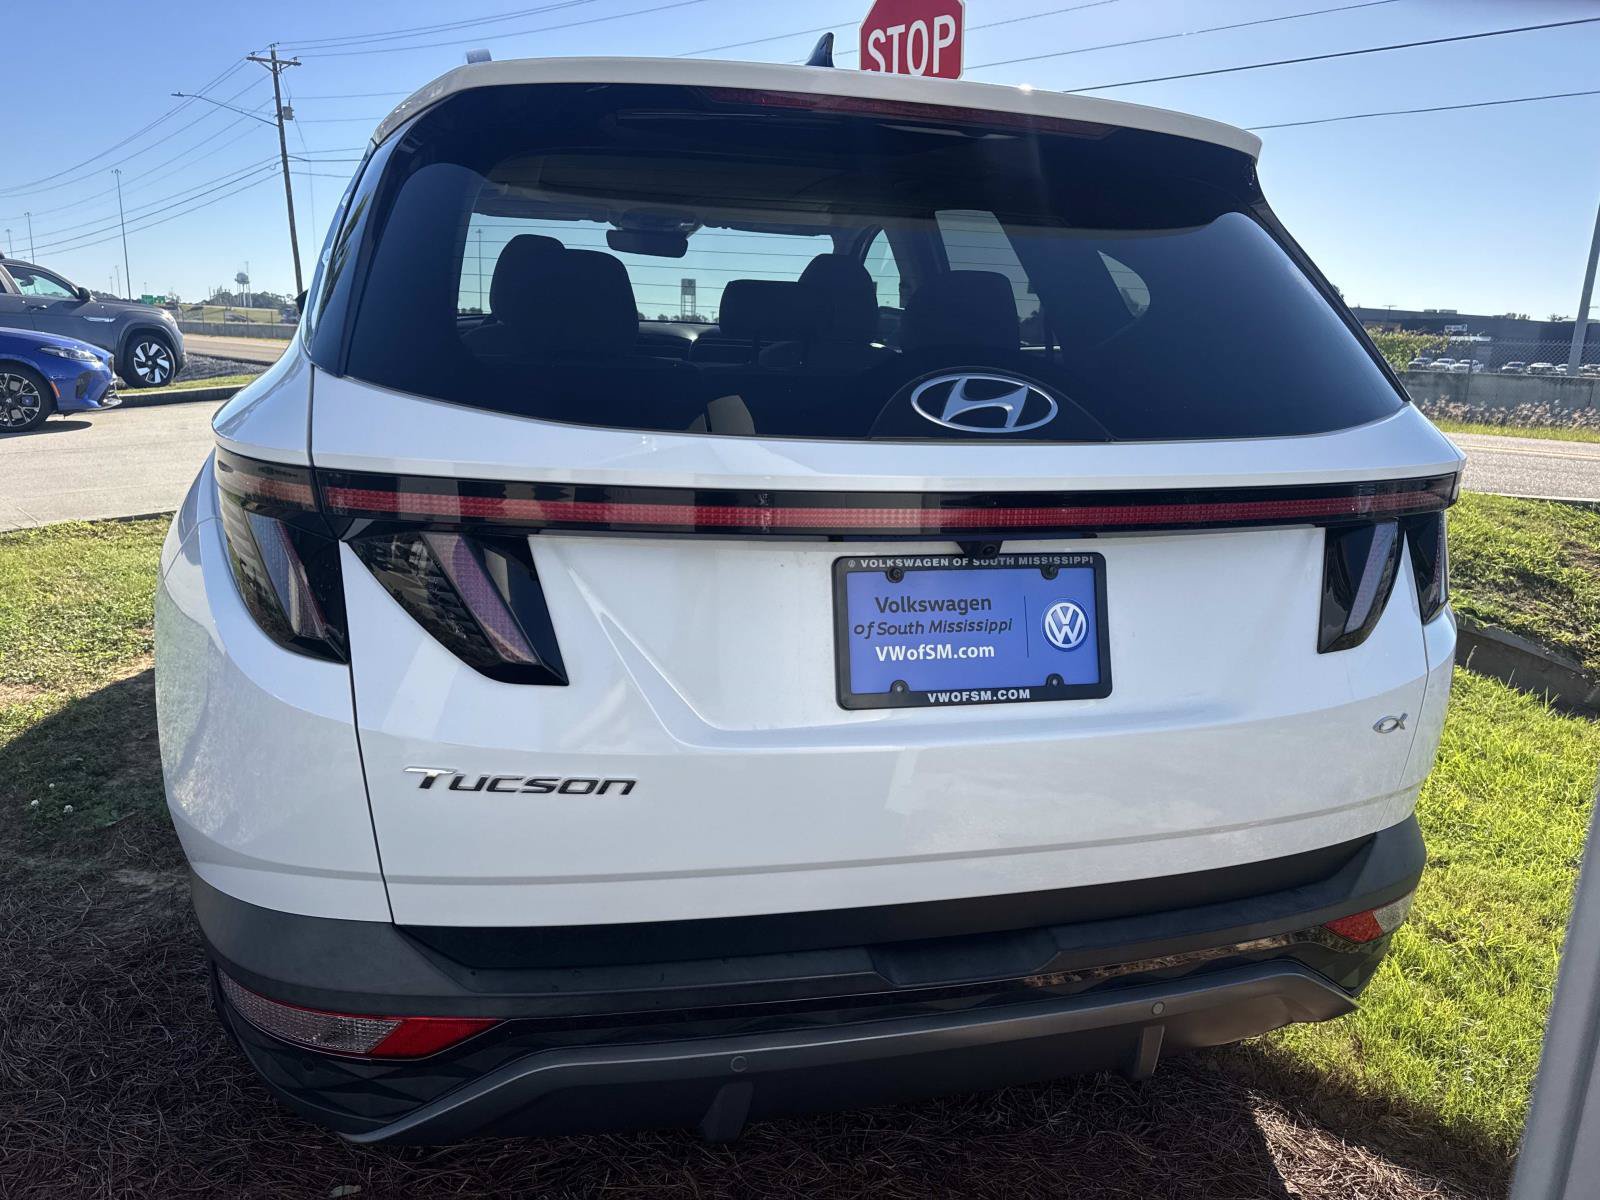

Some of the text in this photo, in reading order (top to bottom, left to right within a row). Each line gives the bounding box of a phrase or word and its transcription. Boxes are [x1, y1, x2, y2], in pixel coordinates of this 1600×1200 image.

[867, 14, 956, 76] STOP
[860, 558, 949, 568] VOLKSWAGEN
[953, 558, 969, 566] OF
[973, 557, 1015, 566] SOUTH
[1018, 556, 1094, 565] MISSISSIPPI
[875, 597, 992, 616] Volkswagen
[854, 618, 1012, 639] of South Mississippi
[875, 643, 995, 662] VWofSM.com
[928, 688, 1031, 704] VWOFSM.COM
